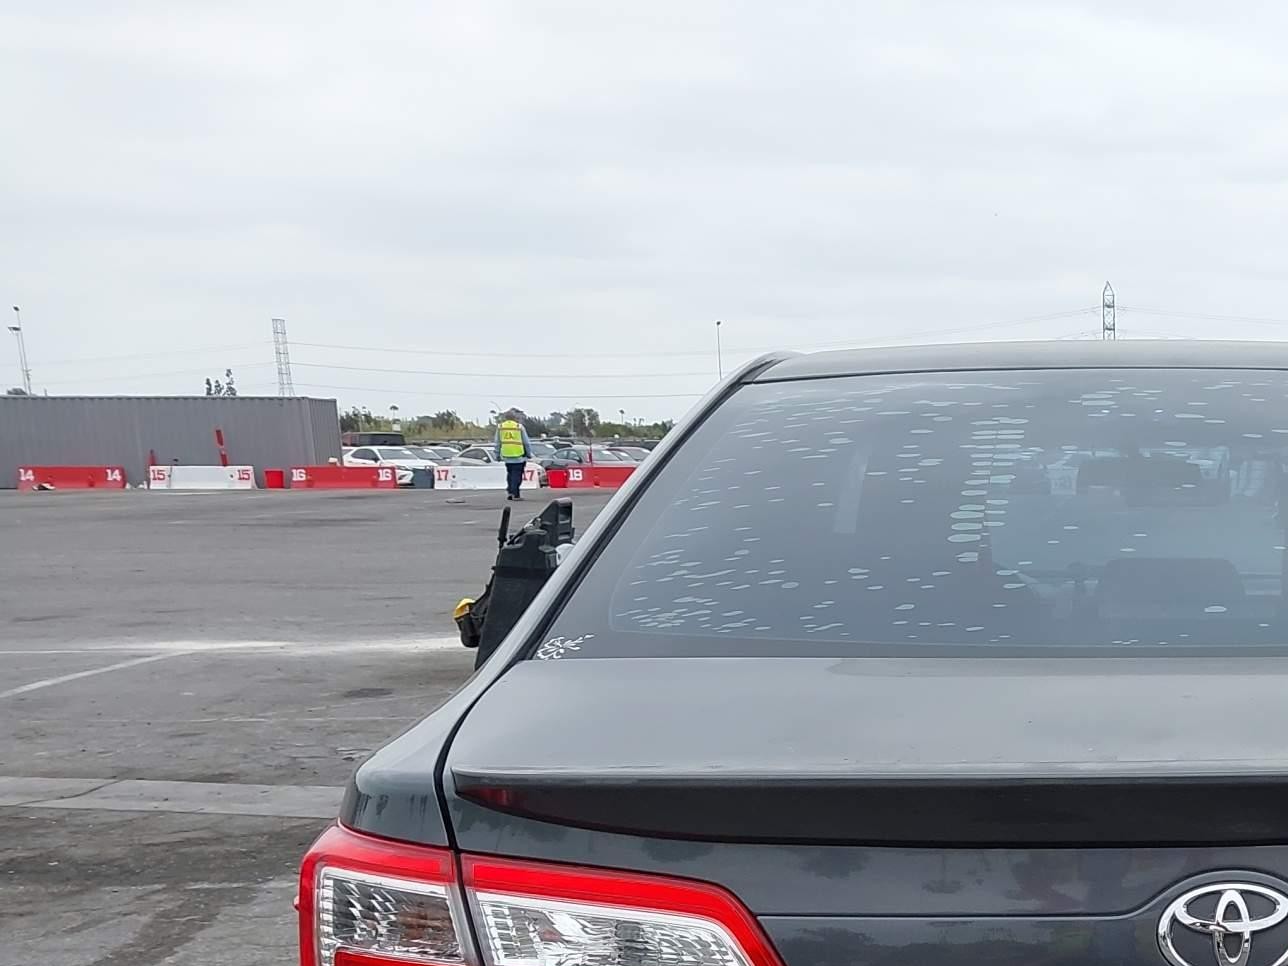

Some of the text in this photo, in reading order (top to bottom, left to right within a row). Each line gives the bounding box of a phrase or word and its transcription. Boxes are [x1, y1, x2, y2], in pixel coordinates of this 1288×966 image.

[19, 468, 34, 480] 14
[106, 469, 122, 481] 14
[151, 469, 166, 480] 15
[237, 469, 251, 480] 15
[291, 469, 306, 480] 16
[378, 469, 392, 480] 16
[436, 470, 449, 480] 17
[568, 469, 582, 480] 18
